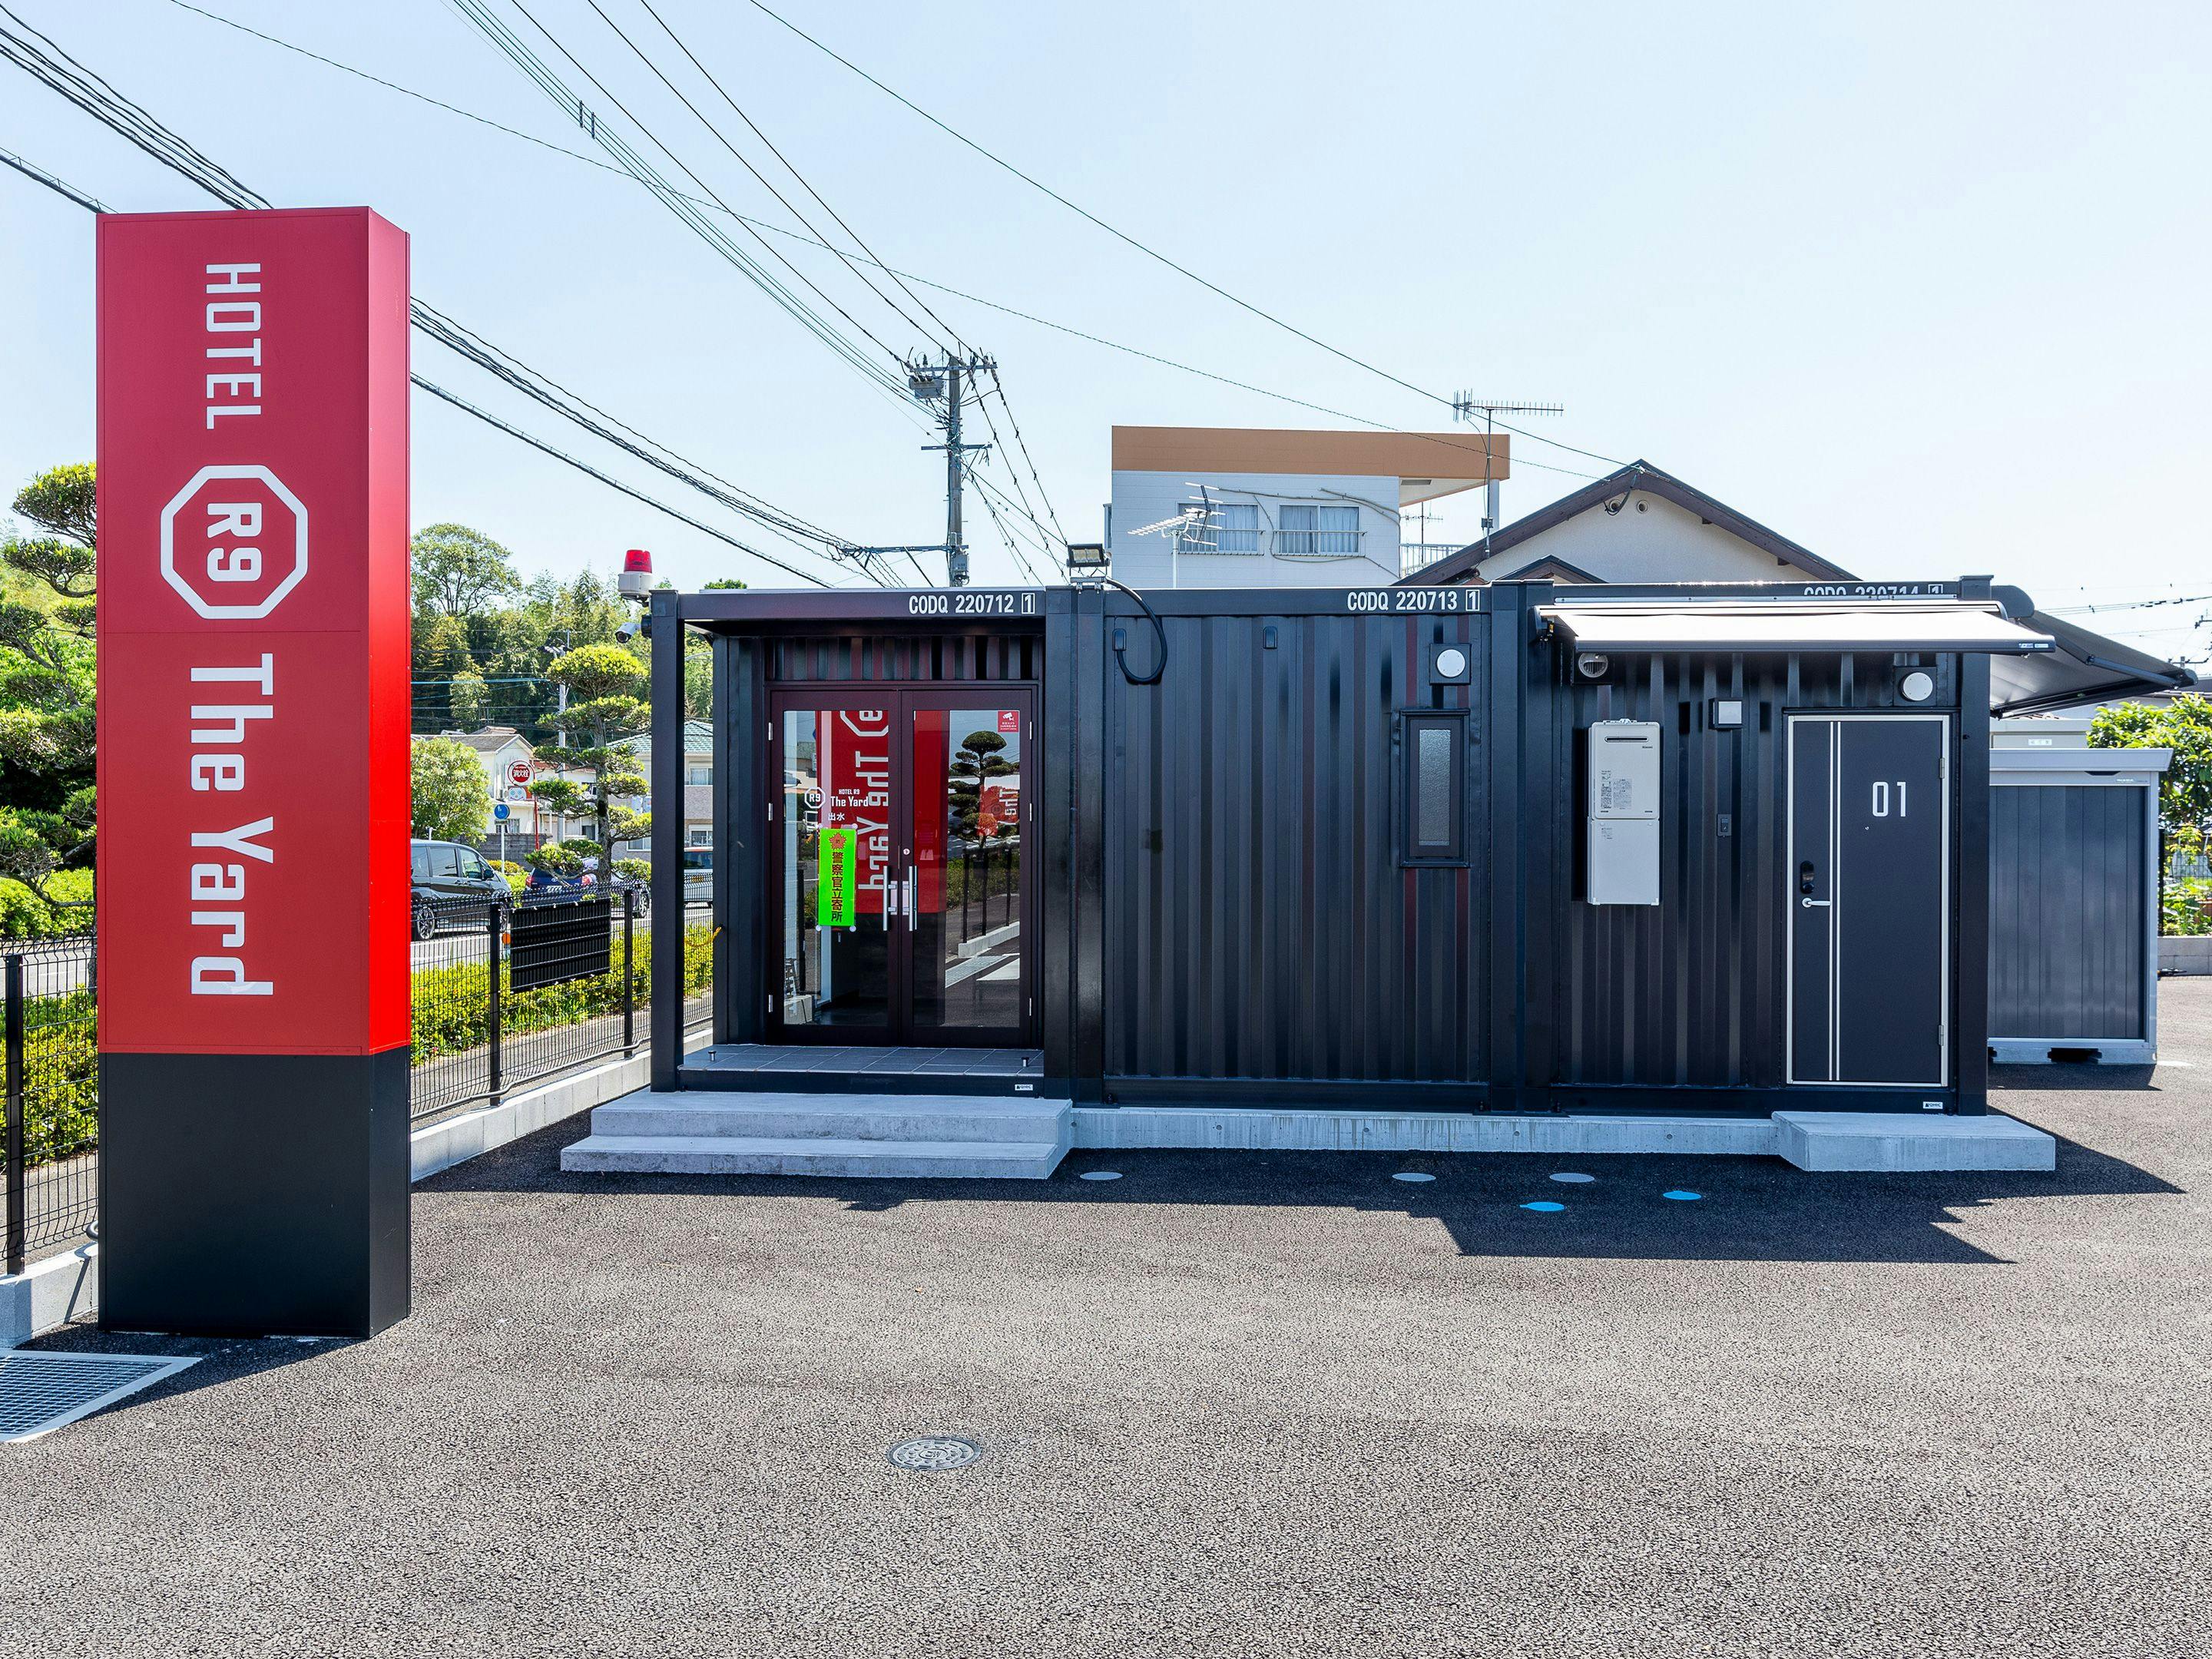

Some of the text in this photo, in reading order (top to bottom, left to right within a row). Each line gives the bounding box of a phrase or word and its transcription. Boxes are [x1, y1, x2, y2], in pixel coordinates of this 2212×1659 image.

[909, 595, 949, 614] CODQ
[955, 594, 1015, 614] 220712
[1347, 591, 1389, 611] CODQ
[1396, 591, 1458, 611] 220713
[190, 263, 273, 995] HOTEL R9 The Yard
[809, 793, 821, 802] R9
[830, 796, 869, 807] The Yard
[1872, 781, 1906, 817] 01
[828, 813, 845, 821] 出水
[831, 852, 843, 922] 警察官立寄所
